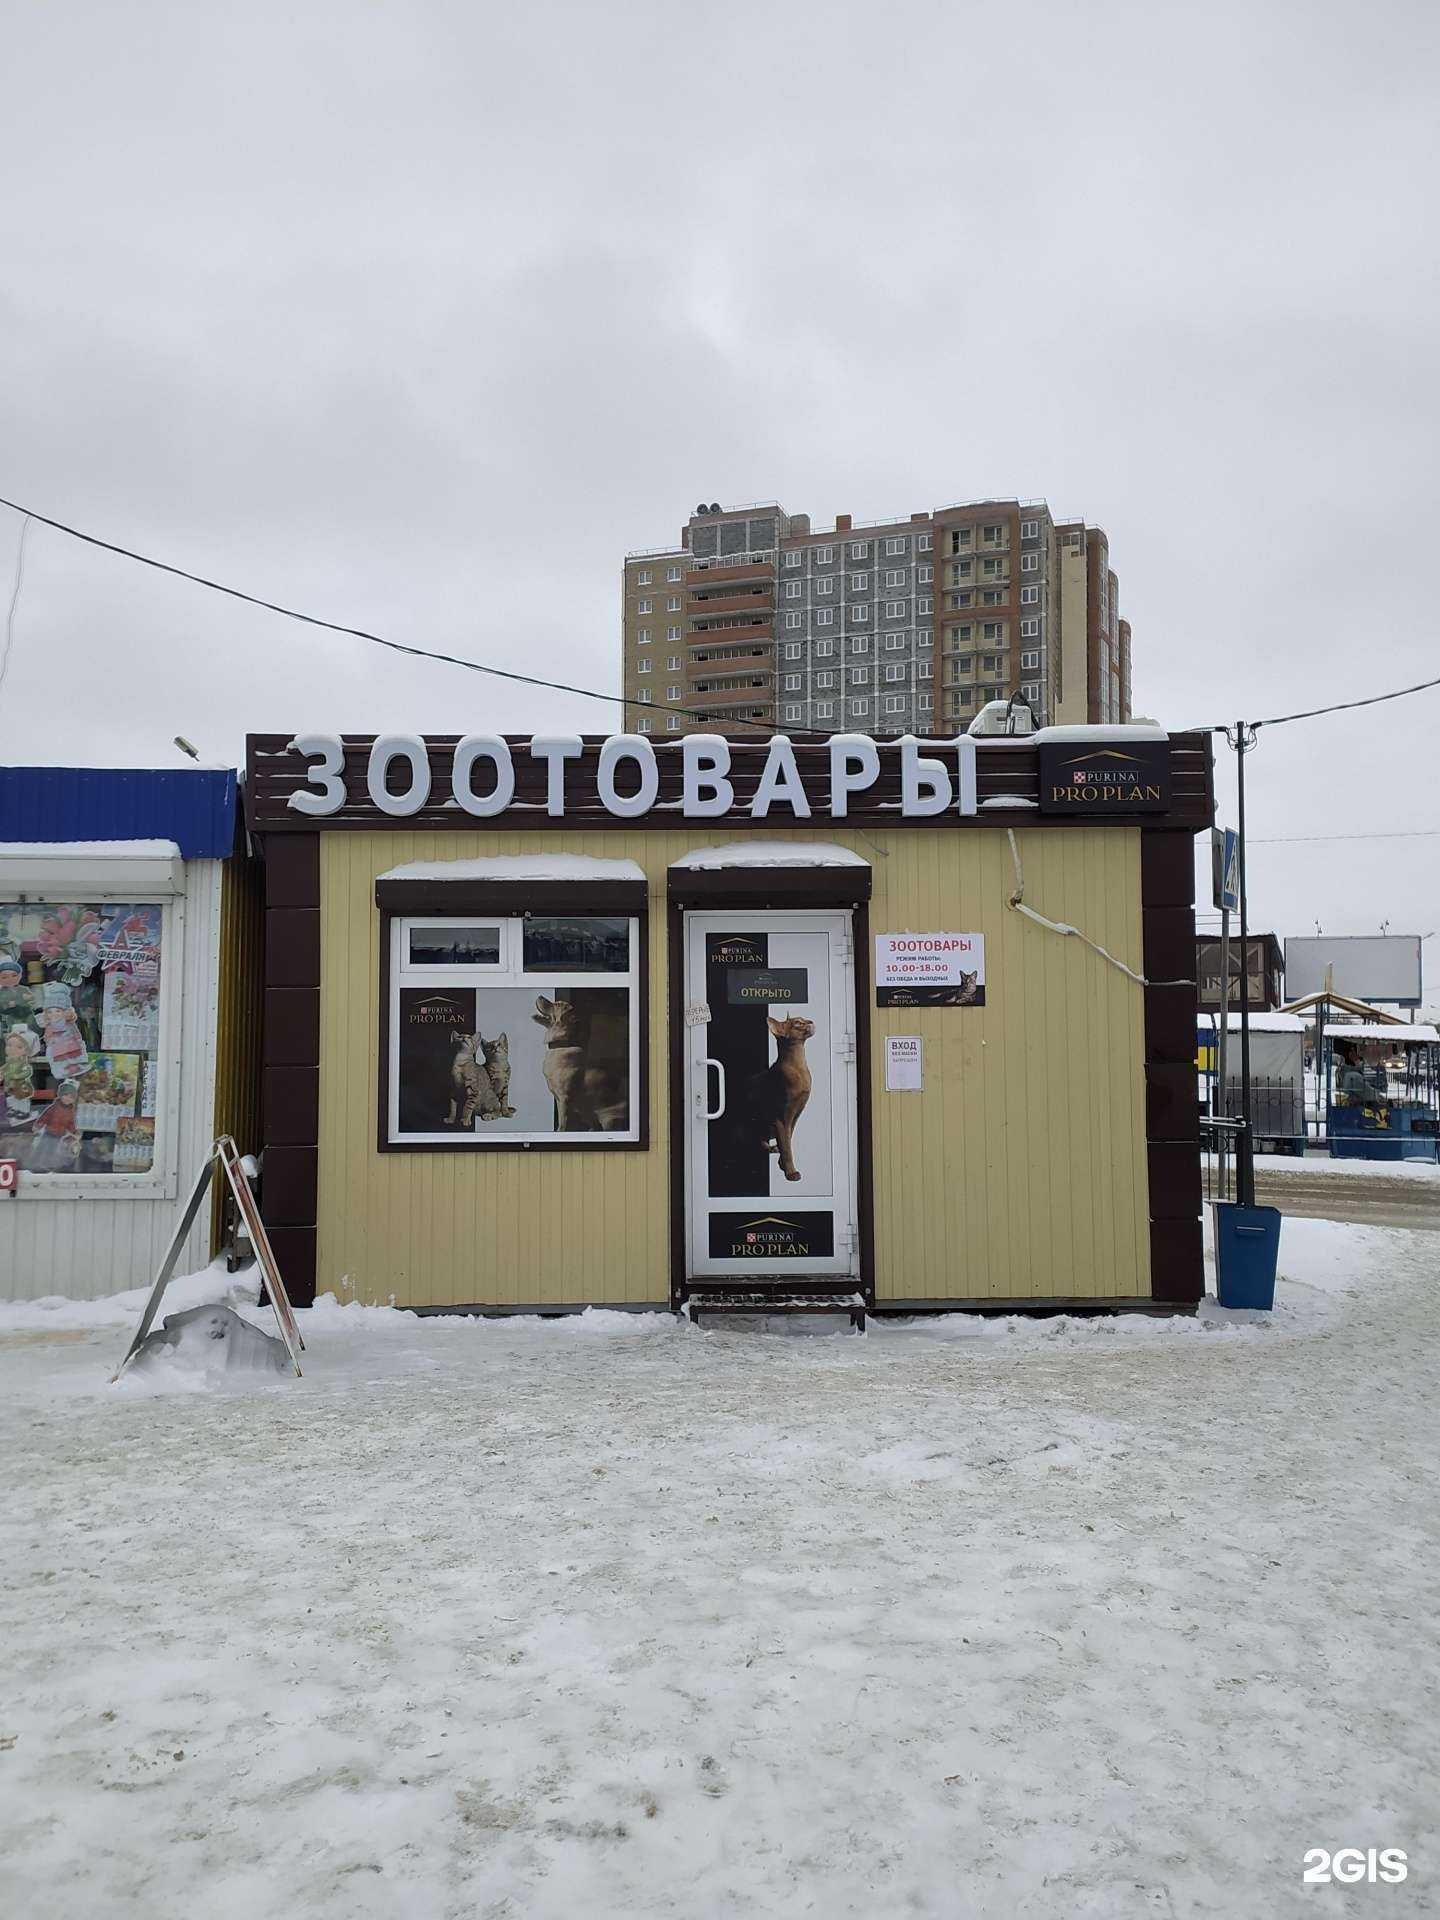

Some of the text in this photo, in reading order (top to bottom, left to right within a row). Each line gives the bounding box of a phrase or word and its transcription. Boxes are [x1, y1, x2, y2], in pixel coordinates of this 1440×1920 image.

[287, 734, 977, 818] ЗООТОВАРЫ
[1087, 772, 1135, 782] PURINA
[889, 940, 971, 952] ЗООТОВАРЫ
[97, 950, 146, 962] ФЕВРАЛЯ
[886, 964, 949, 973] 10.00-18.00
[741, 987, 792, 998] ОТКРЫТО
[891, 1041, 917, 1051] ВХОД
[757, 1233, 792, 1241] PURINA
